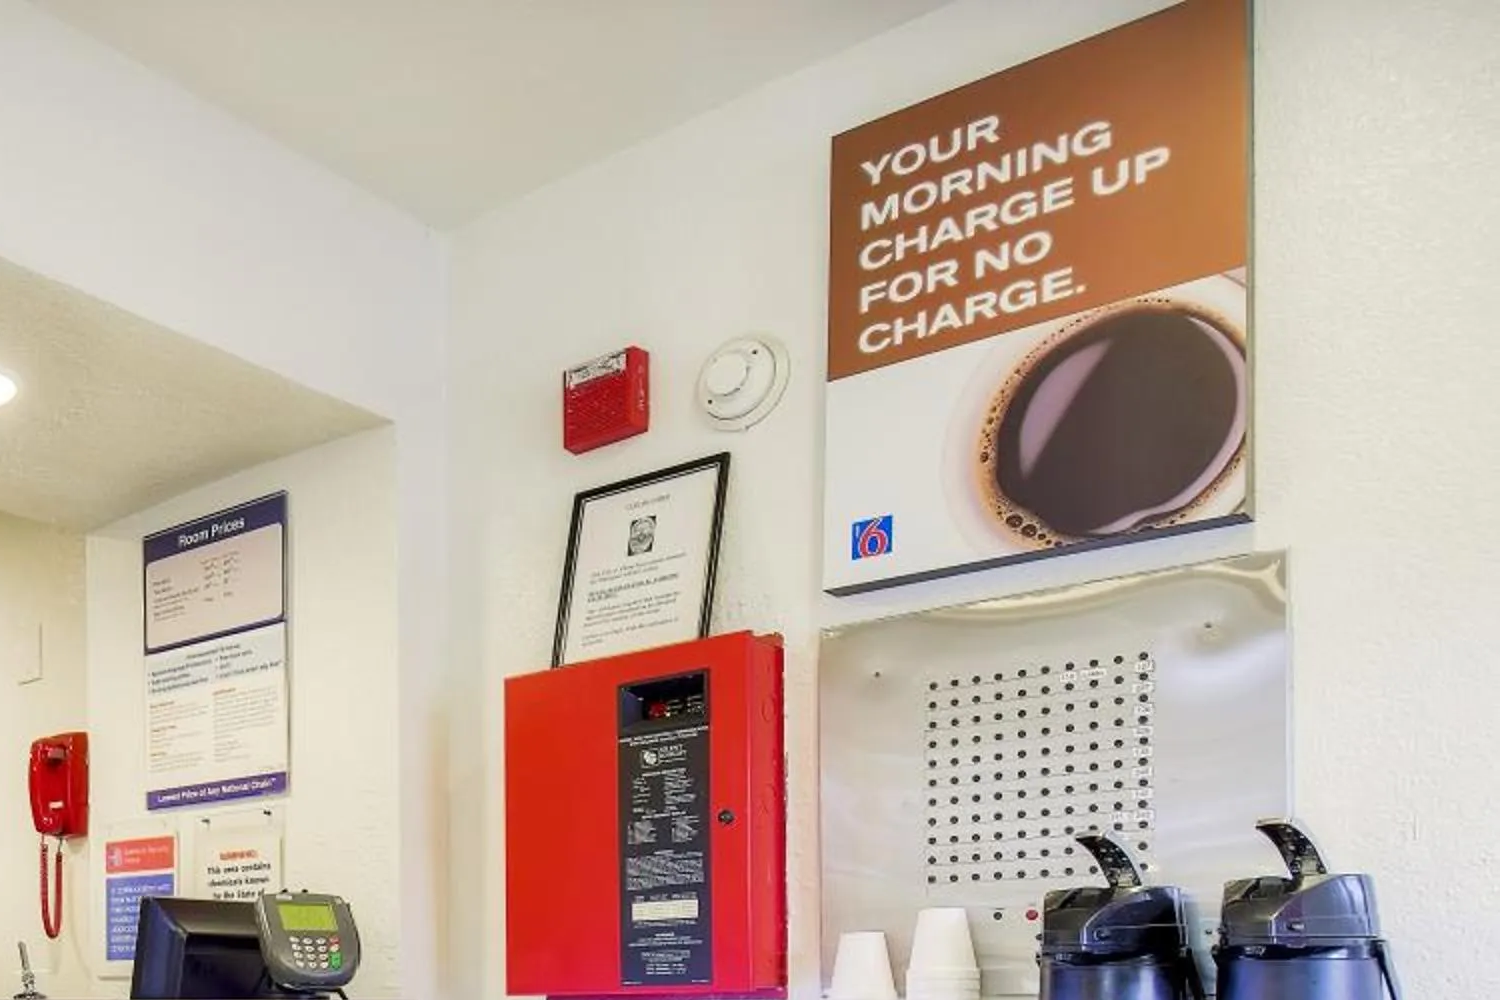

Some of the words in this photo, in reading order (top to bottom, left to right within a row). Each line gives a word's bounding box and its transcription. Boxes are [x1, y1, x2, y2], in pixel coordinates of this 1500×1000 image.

[860, 115, 1000, 186] YOUR
[861, 121, 1112, 230] MORNING
[859, 177, 1075, 270] CHARGE
[1092, 147, 1171, 196] UP
[858, 266, 1087, 353] CHARGE.
[860, 259, 958, 314] FOR
[975, 230, 1053, 278] NO
[178, 529, 209, 548] Room
[211, 517, 245, 537] Prices
[858, 518, 888, 558] 6
